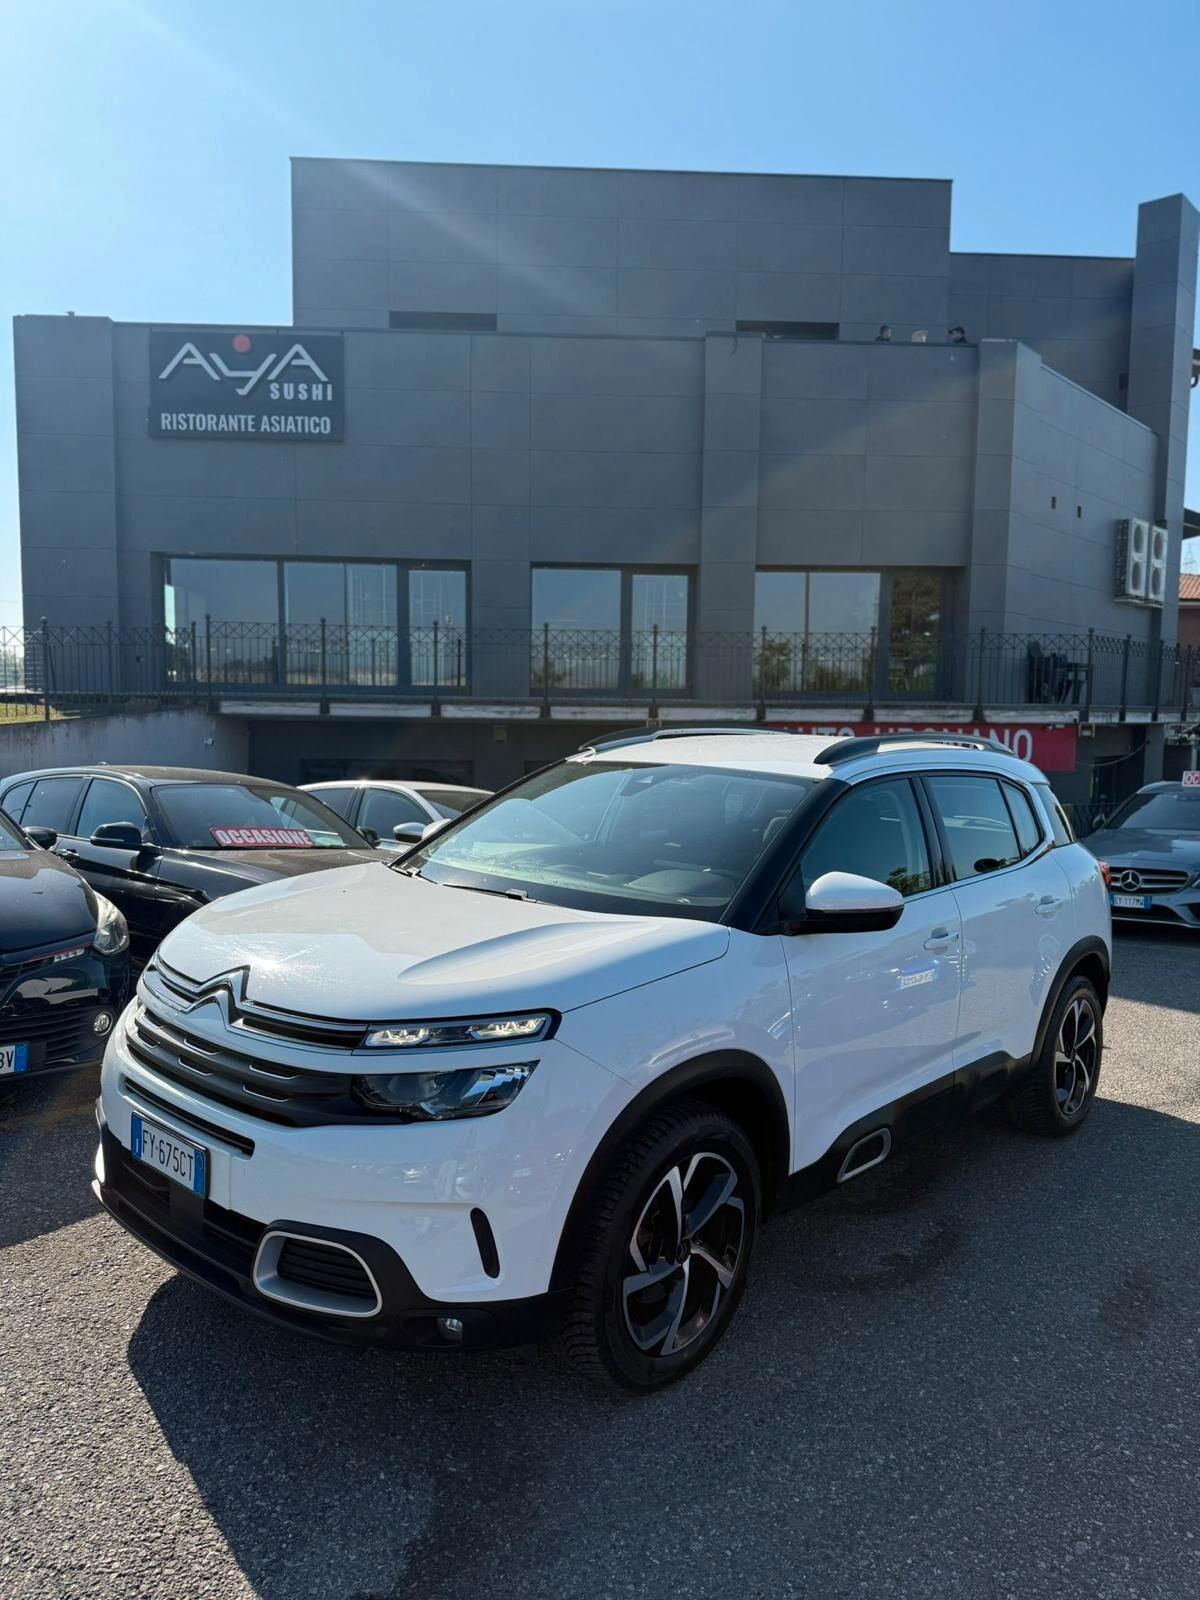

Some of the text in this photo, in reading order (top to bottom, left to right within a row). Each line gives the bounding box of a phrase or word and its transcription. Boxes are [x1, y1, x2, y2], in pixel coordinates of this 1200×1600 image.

[269, 382, 333, 401] SUSHI
[160, 412, 332, 434] RISTORANTE ASIATICO
[215, 829, 313, 846] OCCASIONE
